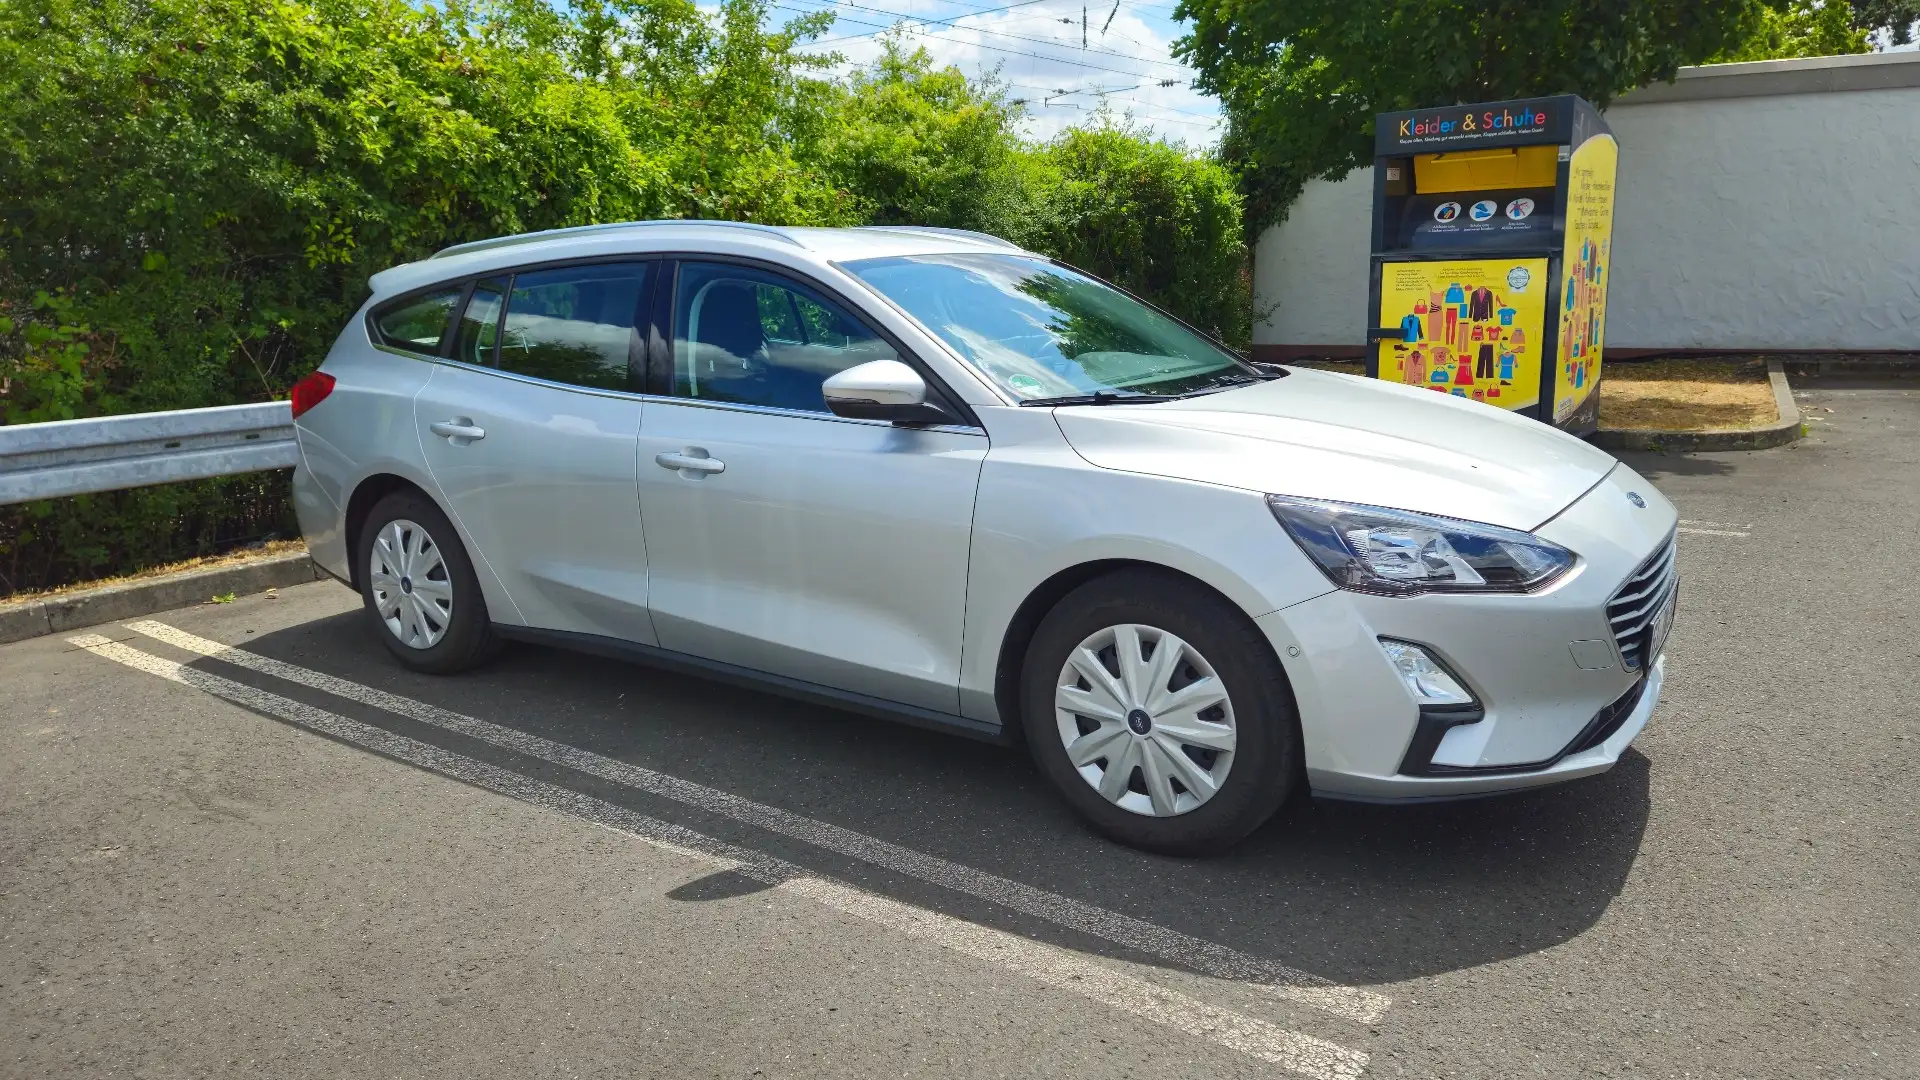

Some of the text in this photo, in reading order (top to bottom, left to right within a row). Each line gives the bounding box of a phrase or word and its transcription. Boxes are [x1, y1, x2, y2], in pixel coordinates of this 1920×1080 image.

[1399, 107, 1545, 137] Kleider & Schuhe
